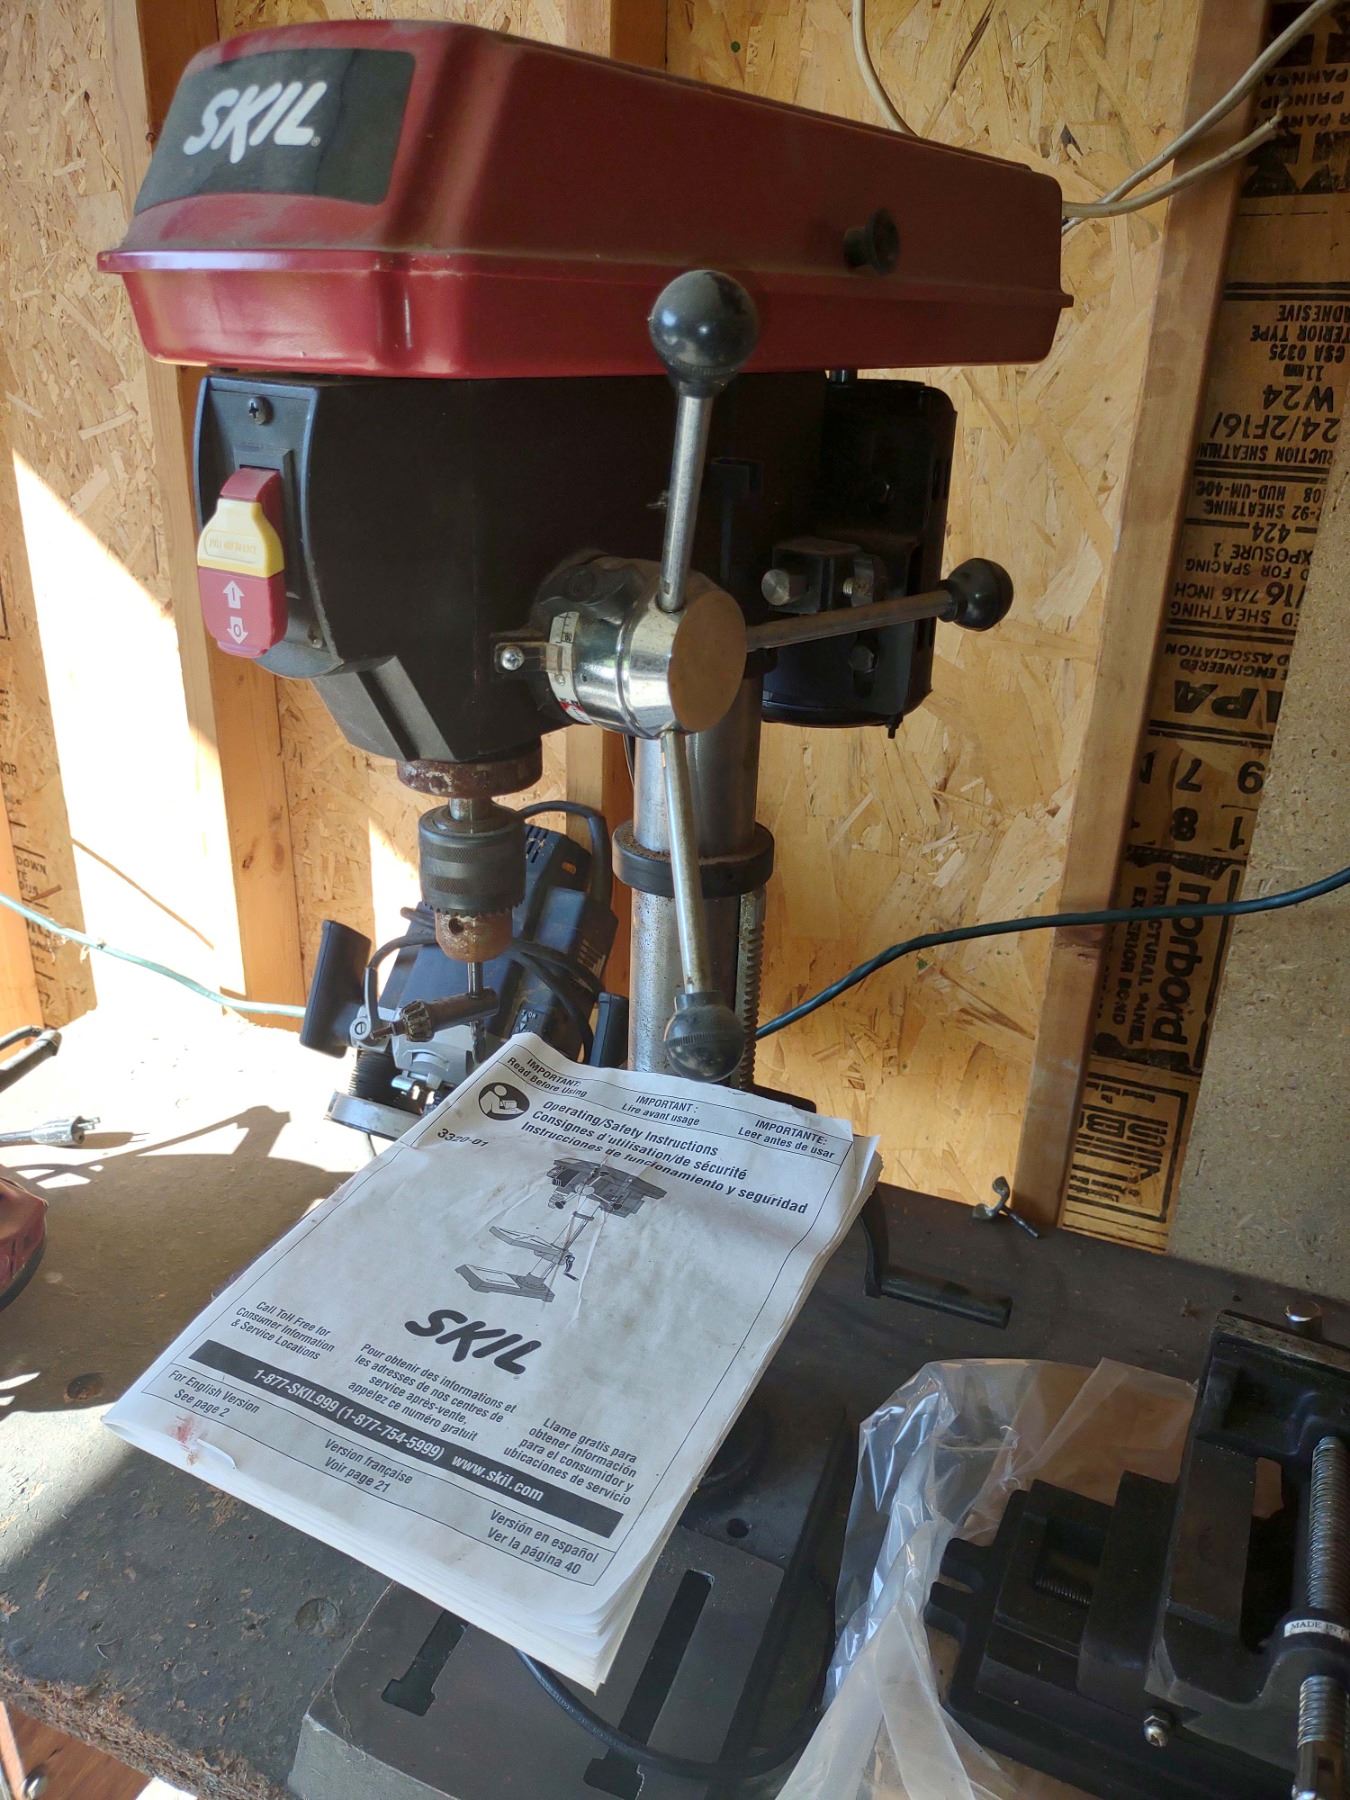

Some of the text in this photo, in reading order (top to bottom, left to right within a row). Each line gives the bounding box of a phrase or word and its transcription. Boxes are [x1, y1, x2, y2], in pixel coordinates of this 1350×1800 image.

[183, 81, 327, 164] SKIL
[1251, 325, 1289, 342] TYPE
[1314, 345, 1346, 363] CSA
[1199, 442, 1268, 462] SHEATHIN
[1204, 499, 1285, 519] SHEATHING
[1213, 543, 1221, 557] 1
[1252, 522, 1290, 544] 424
[1185, 558, 1251, 576] SPACING
[1261, 565, 1292, 580] FOR
[1174, 582, 1214, 599] INCH
[1222, 587, 1259, 604] 7/16
[1170, 602, 1272, 625] SHEATHING
[1165, 643, 1273, 664] ASSOCIATION
[1179, 659, 1276, 680] ENGINEERED
[1176, 759, 1202, 792] 7
[1237, 761, 1265, 794] 9
[1170, 807, 1198, 842] 8
[507, 1057, 588, 1098] Read Before Using
[527, 1059, 581, 1087] IMPORTANT:
[543, 1101, 719, 1156] Operating/Safety Instructions
[622, 1103, 700, 1126] Lire avant usage
[755, 1120, 828, 1145] IMPORTANTE:
[1079, 1111, 1168, 1148] SB
[532, 1111, 748, 1180] Consignes d'utilisation/de sécurité
[738, 1127, 835, 1158] Leer antes de usar
[521, 1121, 808, 1214] Instrucciones de funcionamiento y seguridad
[236, 1307, 335, 1352] Consumer Information
[256, 1301, 331, 1337] Call Toll Free for
[231, 1318, 321, 1360] & Service Locations
[404, 1309, 542, 1375] SKIL
[168, 1369, 260, 1414] For English Version
[354, 1354, 504, 1423] les adresses de nos centres de
[360, 1343, 518, 1413] Pour obtenir des informations et
[174, 1389, 231, 1418] See page 2
[348, 1382, 479, 1442] appelez ce numéro gratuit
[369, 1376, 467, 1425] service après-vente,
[254, 1369, 545, 1502] 1-877-SKIL999 (1-877-754-5999) www.skil.com
[528, 1427, 637, 1478] obtener información
[543, 1417, 638, 1464] Llame gratis para
[324, 1439, 414, 1485] Version française
[324, 1456, 392, 1493] Voir page 21
[503, 1446, 631, 1506] ubicaciones de servicio
[518, 1438, 635, 1493] para el consumidor y
[487, 1526, 582, 1575] Ver la página 40
[490, 1509, 599, 1563] Versión en español
[1291, 1621, 1322, 1630] MADE
